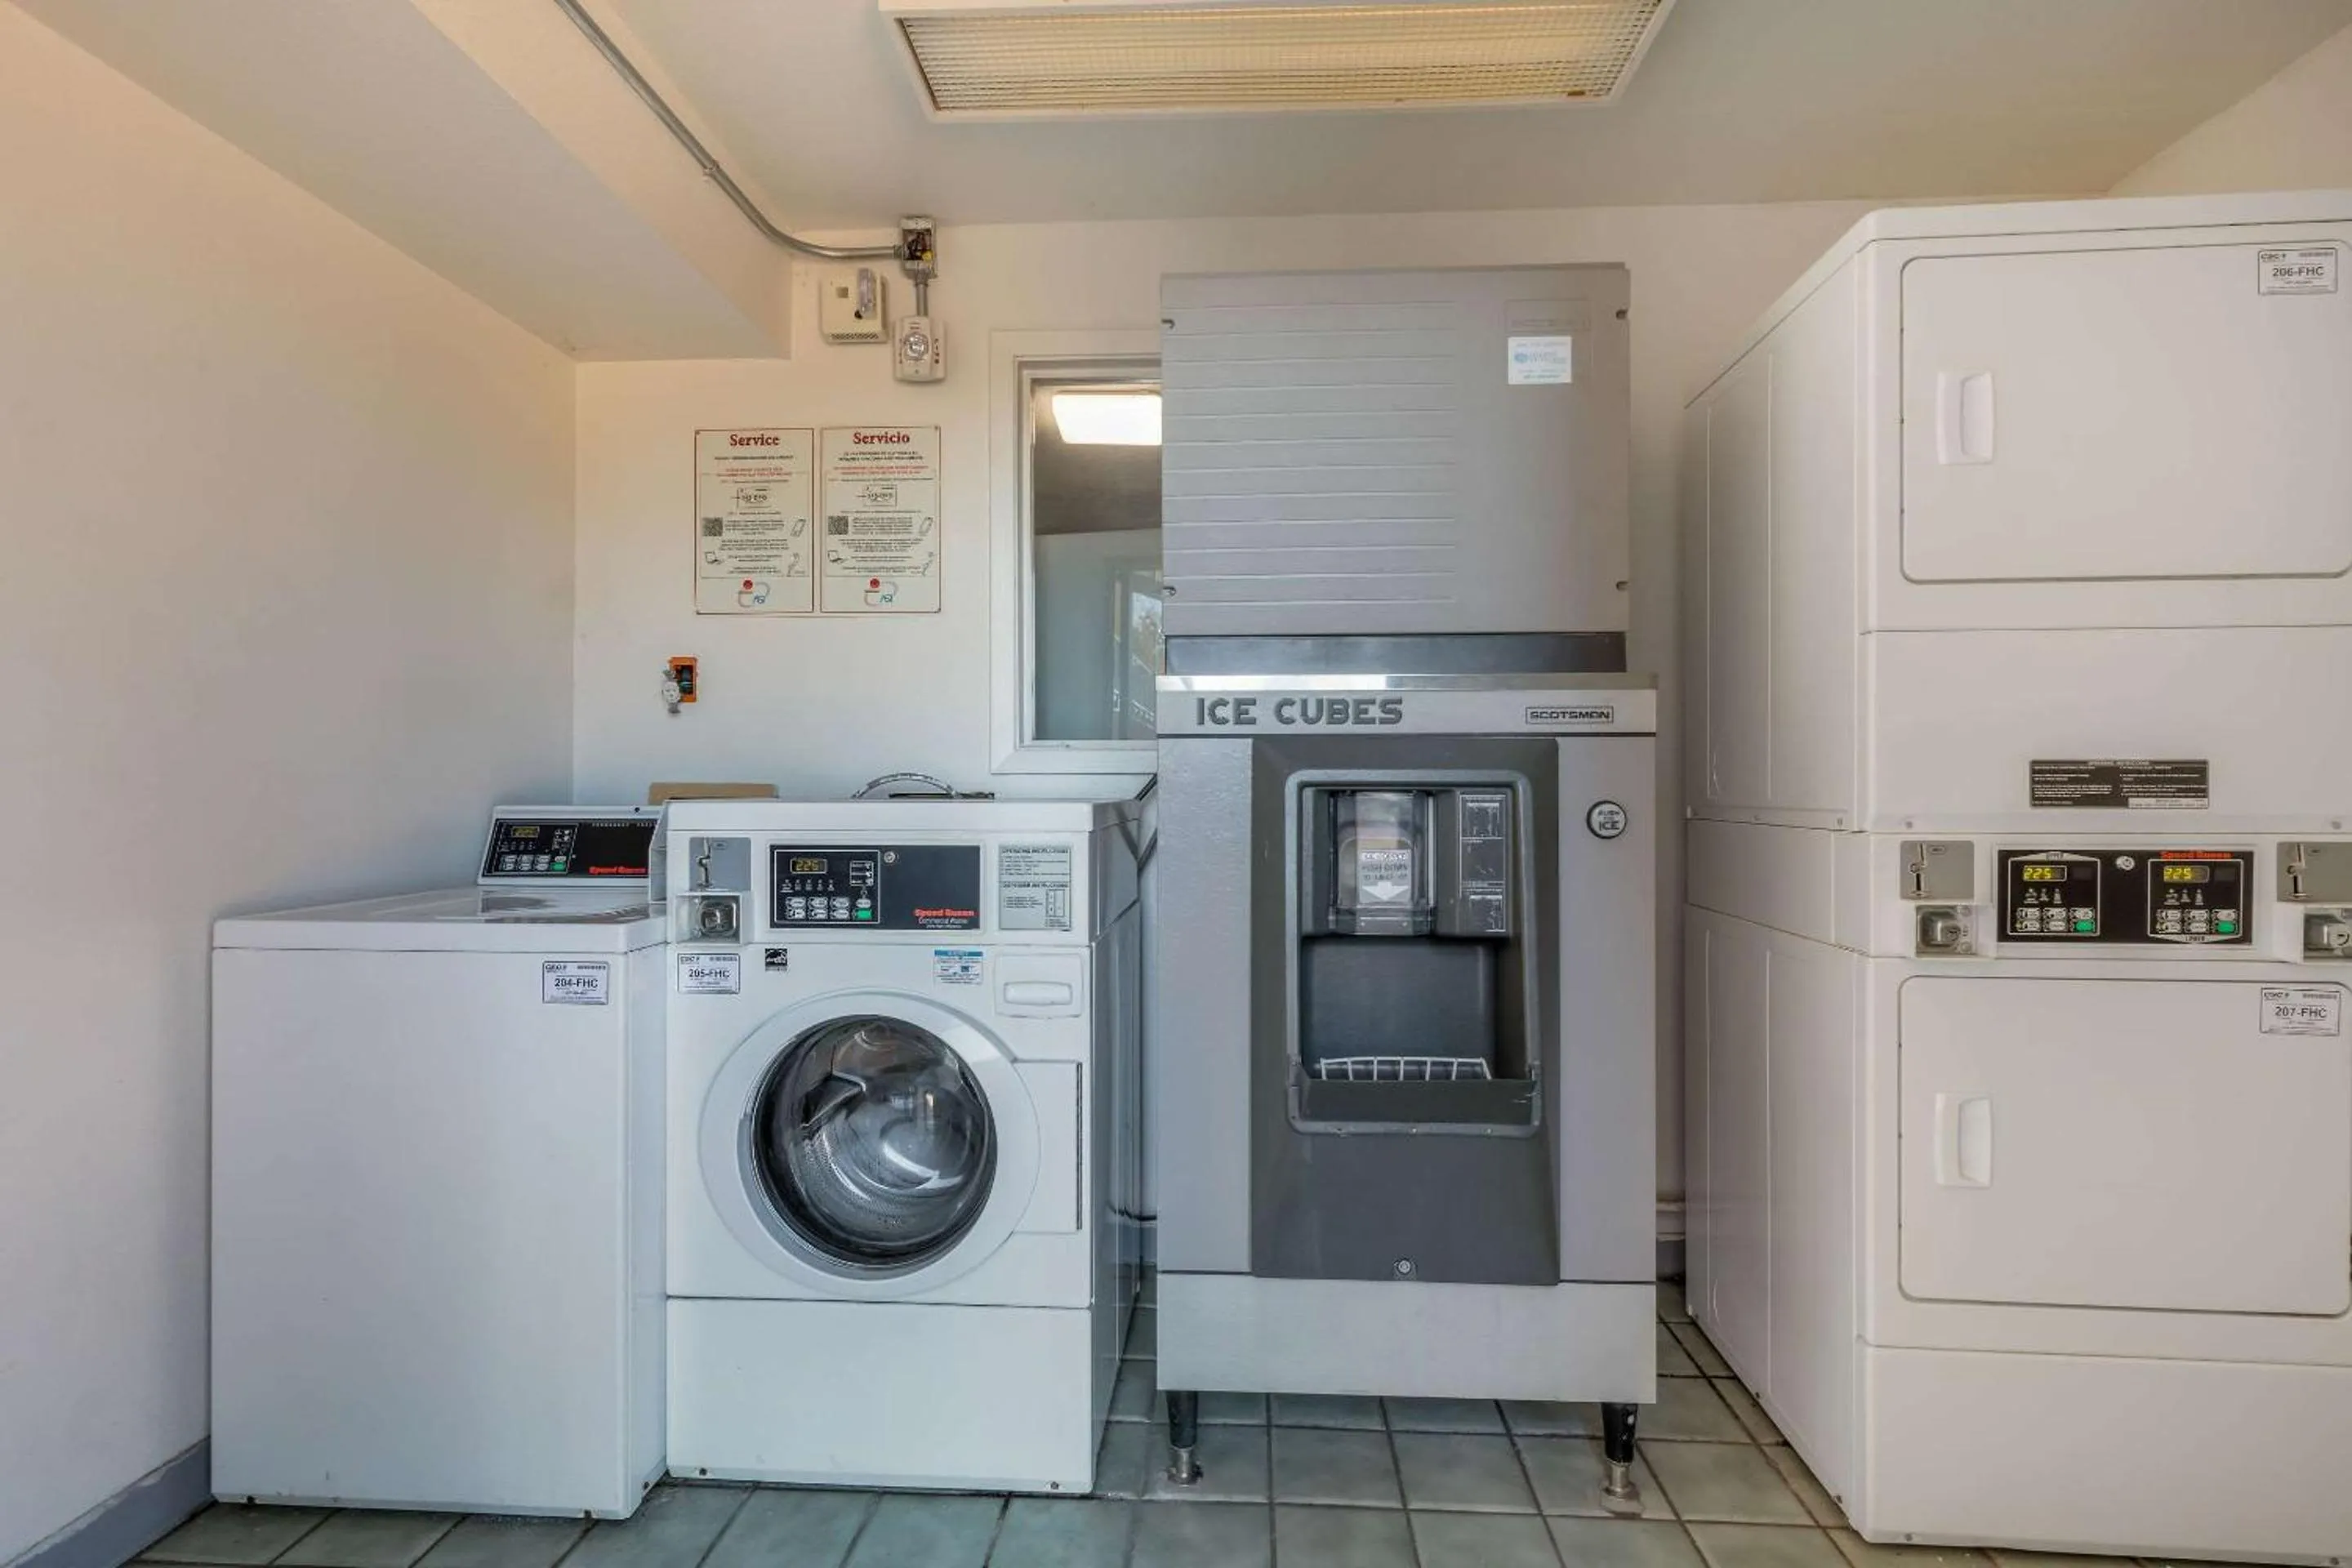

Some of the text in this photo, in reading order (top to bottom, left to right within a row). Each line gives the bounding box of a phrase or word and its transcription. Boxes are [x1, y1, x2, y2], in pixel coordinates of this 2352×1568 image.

[2272, 265, 2325, 277] 206-FHC
[729, 434, 781, 447] Service
[853, 431, 910, 444] Servicio
[1196, 697, 1403, 725] ICE CUBES
[1530, 710, 1610, 719] SCOTSMAN
[1598, 821, 1619, 831] ICE
[2024, 867, 2052, 880] 225
[2164, 867, 2192, 880] 225
[915, 908, 975, 917] Speed Queen
[688, 969, 730, 978] 205-FHC
[555, 978, 599, 988] 204-FHC
[2274, 1005, 2328, 1018] 207-FHC
